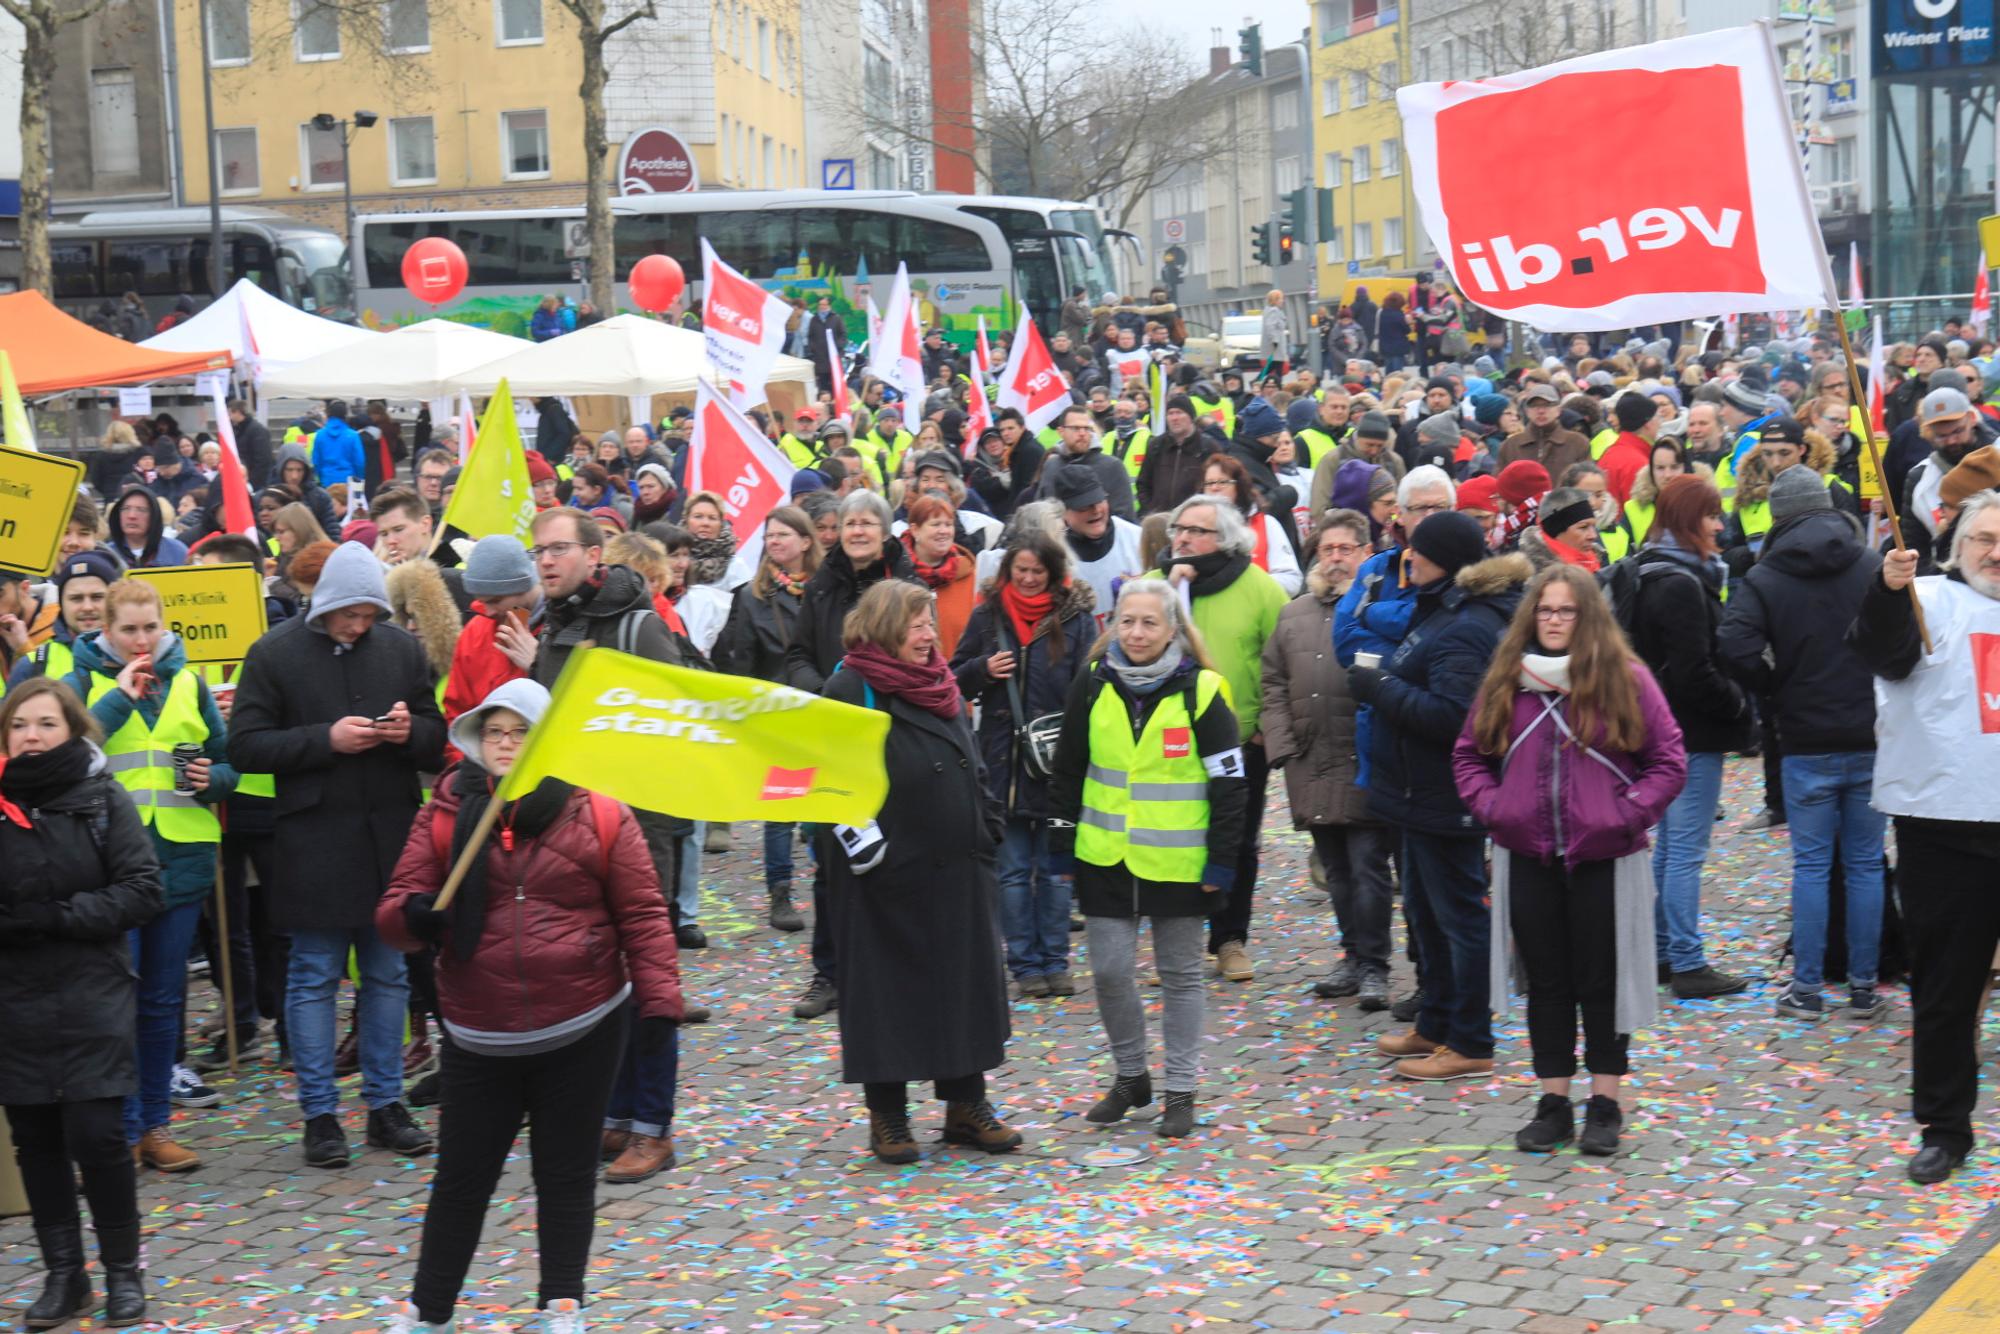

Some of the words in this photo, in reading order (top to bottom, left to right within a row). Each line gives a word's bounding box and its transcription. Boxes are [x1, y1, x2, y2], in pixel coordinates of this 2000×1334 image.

[1883, 31, 1943, 48] Wiener
[1947, 26, 1991, 42] Platz
[629, 156, 688, 173] Apotheke
[711, 300, 760, 336] ver.di
[163, 592, 228, 608] LVR-Klinik
[171, 621, 228, 640] Bonn
[582, 711, 736, 744] stark.
